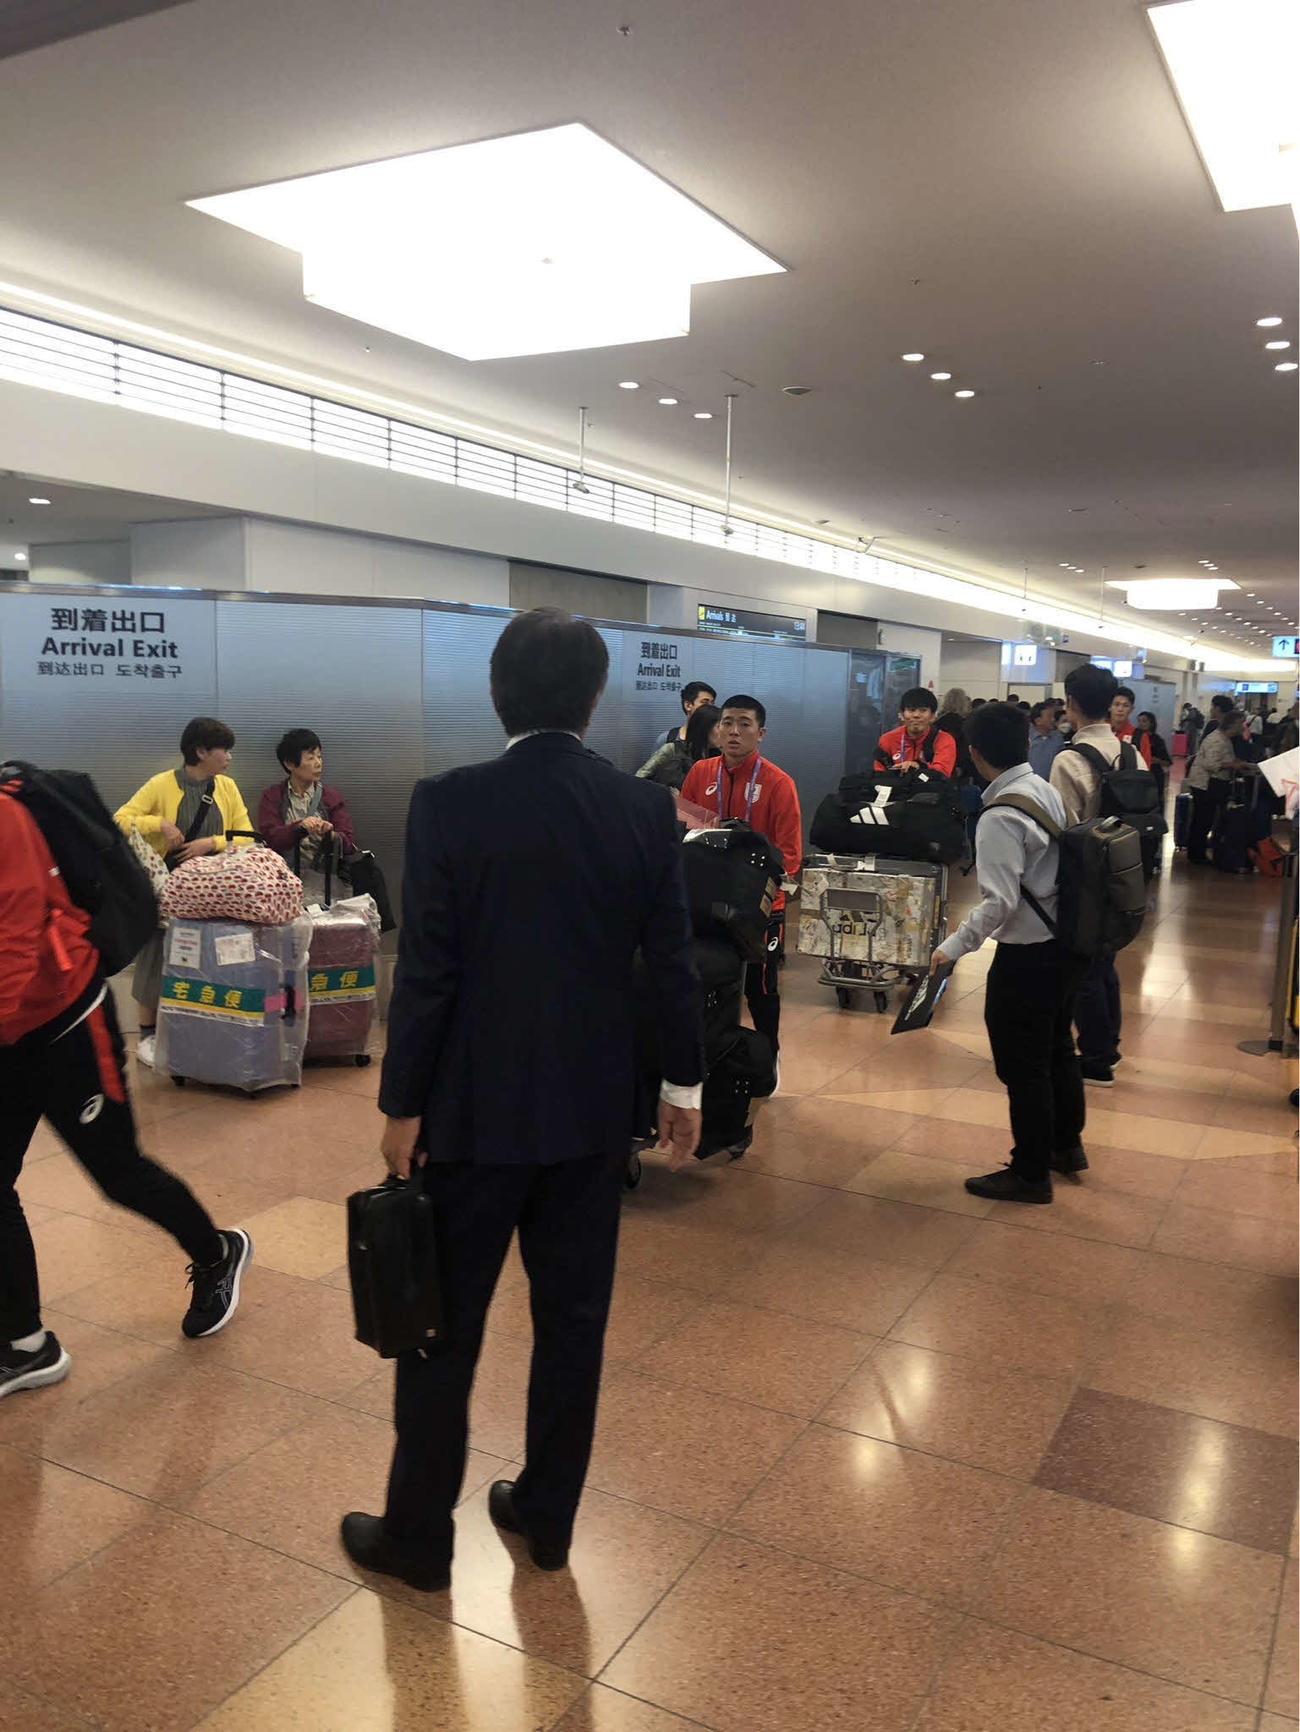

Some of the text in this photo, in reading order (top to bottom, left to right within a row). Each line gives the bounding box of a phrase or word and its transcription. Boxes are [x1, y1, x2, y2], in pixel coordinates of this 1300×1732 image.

[51, 608, 165, 633] 到着出口
[41, 637, 178, 658] Arrival Exit
[641, 641, 678, 660] 到着出口
[37, 661, 104, 676] 到达出口
[115, 663, 183, 679] 도착출구
[637, 662, 681, 678] Arrival Exit
[173, 981, 243, 1009] 宅急便
